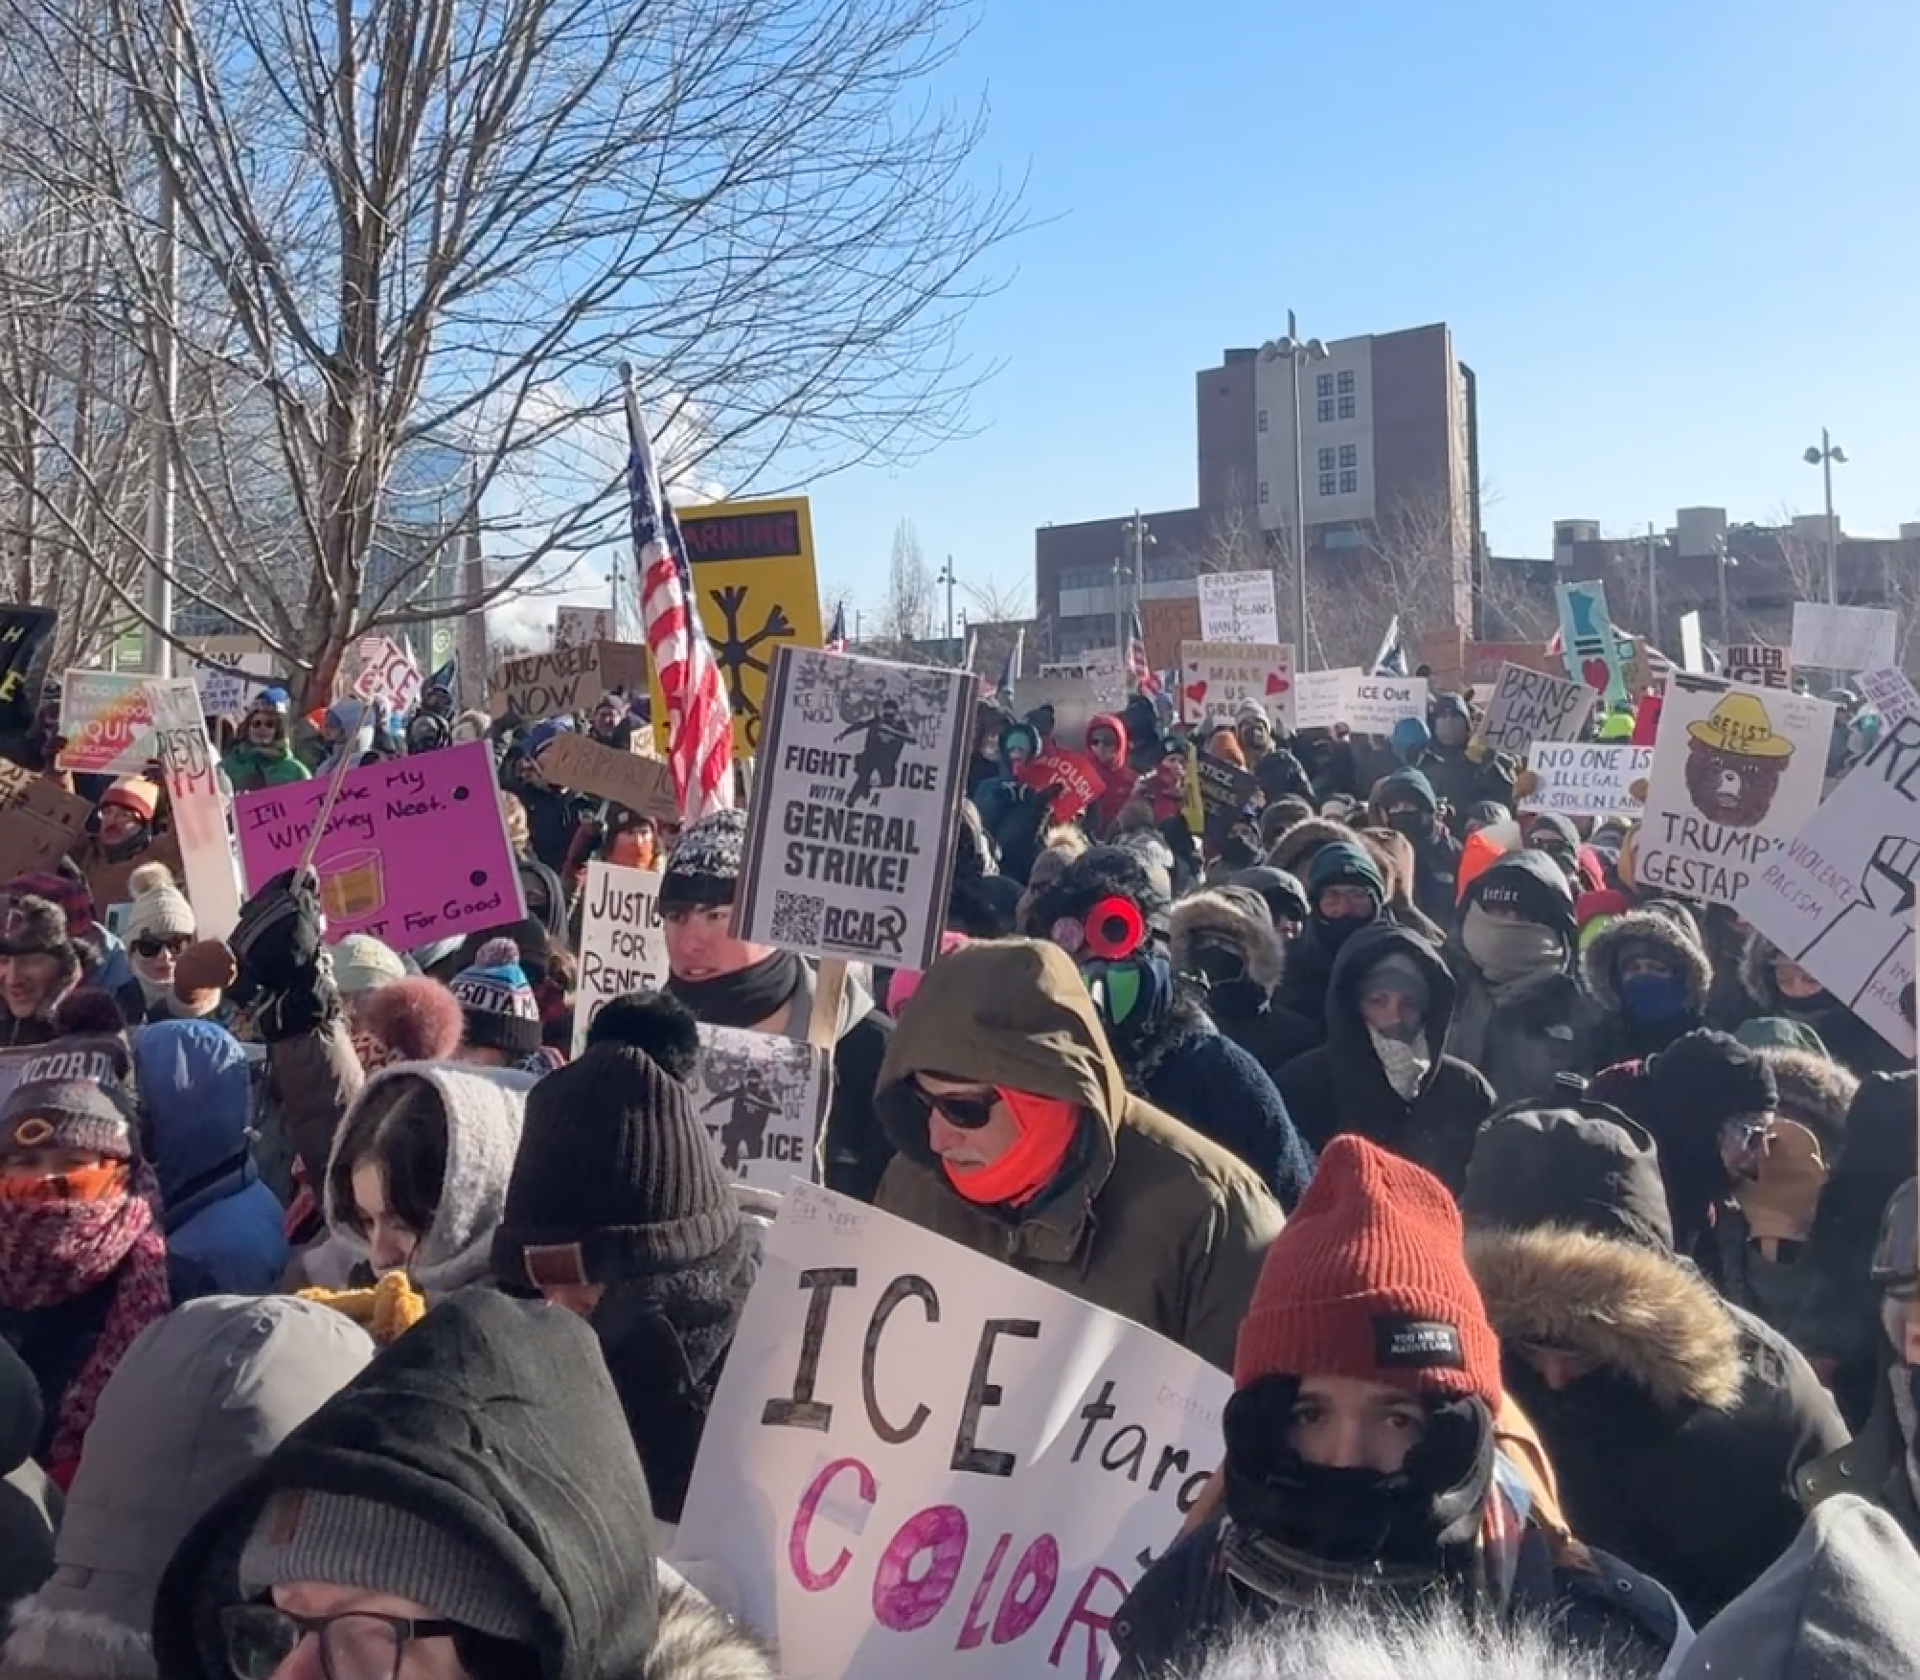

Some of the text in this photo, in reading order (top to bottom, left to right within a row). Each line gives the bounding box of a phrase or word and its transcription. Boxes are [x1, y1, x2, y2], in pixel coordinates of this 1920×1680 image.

[1208, 666, 1261, 681] MAKE
[1501, 667, 1581, 714] BRING
[507, 675, 580, 716] NOW
[1224, 685, 1247, 700] US
[1357, 686, 1411, 702] ICE Out
[1706, 713, 1769, 741] RESIST
[1720, 733, 1750, 753] ICE
[784, 744, 939, 792] FIGHT ICE
[1537, 748, 1653, 771] NO ONE IS
[808, 783, 881, 807] WITH A
[1551, 771, 1623, 788] ILLEGAL
[249, 769, 425, 831] I'll Tke My
[783, 800, 921, 855] GENERAL
[783, 840, 910, 894] STRIKE!
[1787, 831, 1858, 902] VIOLENCE
[1761, 864, 1823, 922] RACISM
[403, 909, 438, 932] For
[443, 892, 503, 920] Good
[823, 905, 876, 943] RCA
[611, 930, 647, 962] FOR
[767, 1132, 804, 1162] ICE
[738, 1163, 749, 1179] A
[760, 1266, 1042, 1478] ICE
